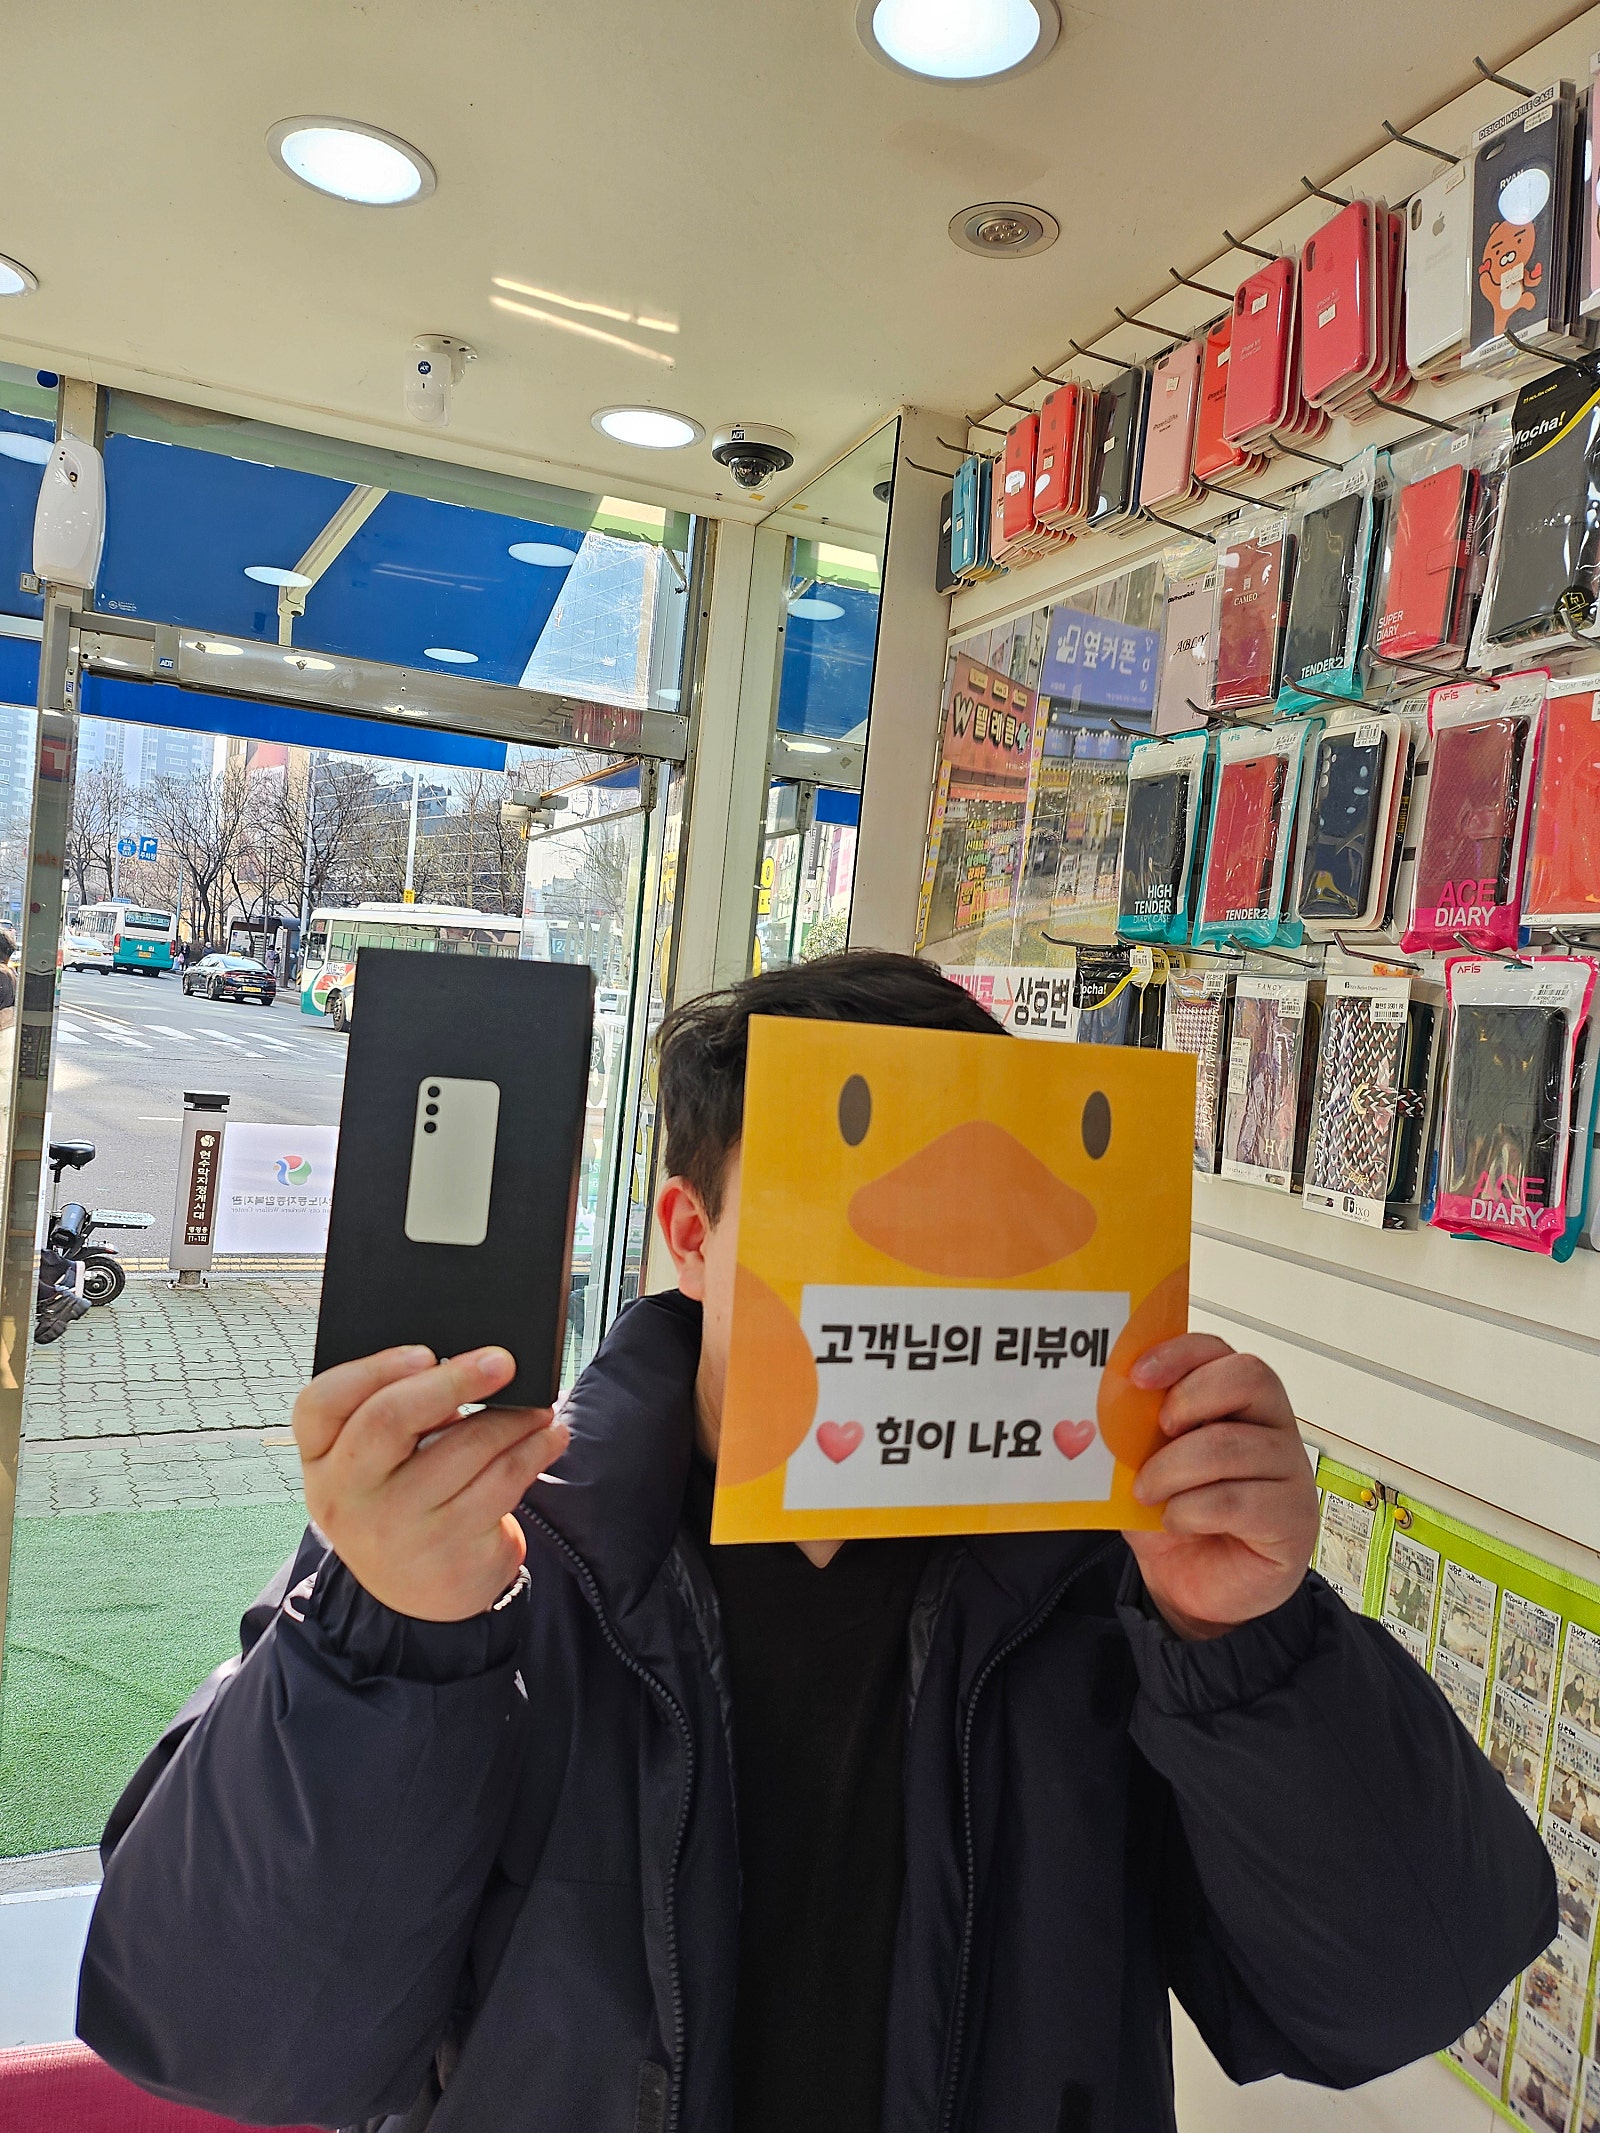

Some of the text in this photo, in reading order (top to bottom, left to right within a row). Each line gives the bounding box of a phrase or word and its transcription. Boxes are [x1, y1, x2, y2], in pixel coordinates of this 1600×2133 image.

[1478, 116, 1506, 141] DESIGN
[1505, 100, 1533, 124] MOBILE
[1533, 86, 1554, 108] CASE
[731, 432, 744, 440] ADT
[1464, 513, 1476, 556] SUPER DIARY
[1234, 592, 1258, 606] CAMEO
[1378, 610, 1404, 629] SUPER
[1376, 624, 1400, 642] DIARY
[160, 659, 173, 668] ADT
[1083, 630, 1137, 675] 옆커폰
[1301, 656, 1344, 679] TENDER2
[1148, 884, 1173, 900] HIGH
[1437, 878, 1498, 906] ACE
[1134, 900, 1172, 915] TENDER
[1152, 913, 1171, 923] CASE
[1225, 908, 1268, 921] TENDER2
[1435, 906, 1496, 927] DIARY
[1257, 983, 1281, 991] FANCY
[1014, 976, 1074, 1029] 상호변
[1200, 1070, 1216, 1132] DESIGN
[193, 1150, 212, 1220] 현수막지정게시대
[1472, 1170, 1545, 1206] ACE
[1470, 1198, 1545, 1230] DIARY
[815, 1323, 1110, 1370] 고객님의 리뷰에
[876, 1416, 1042, 1465] 힘이 나요
